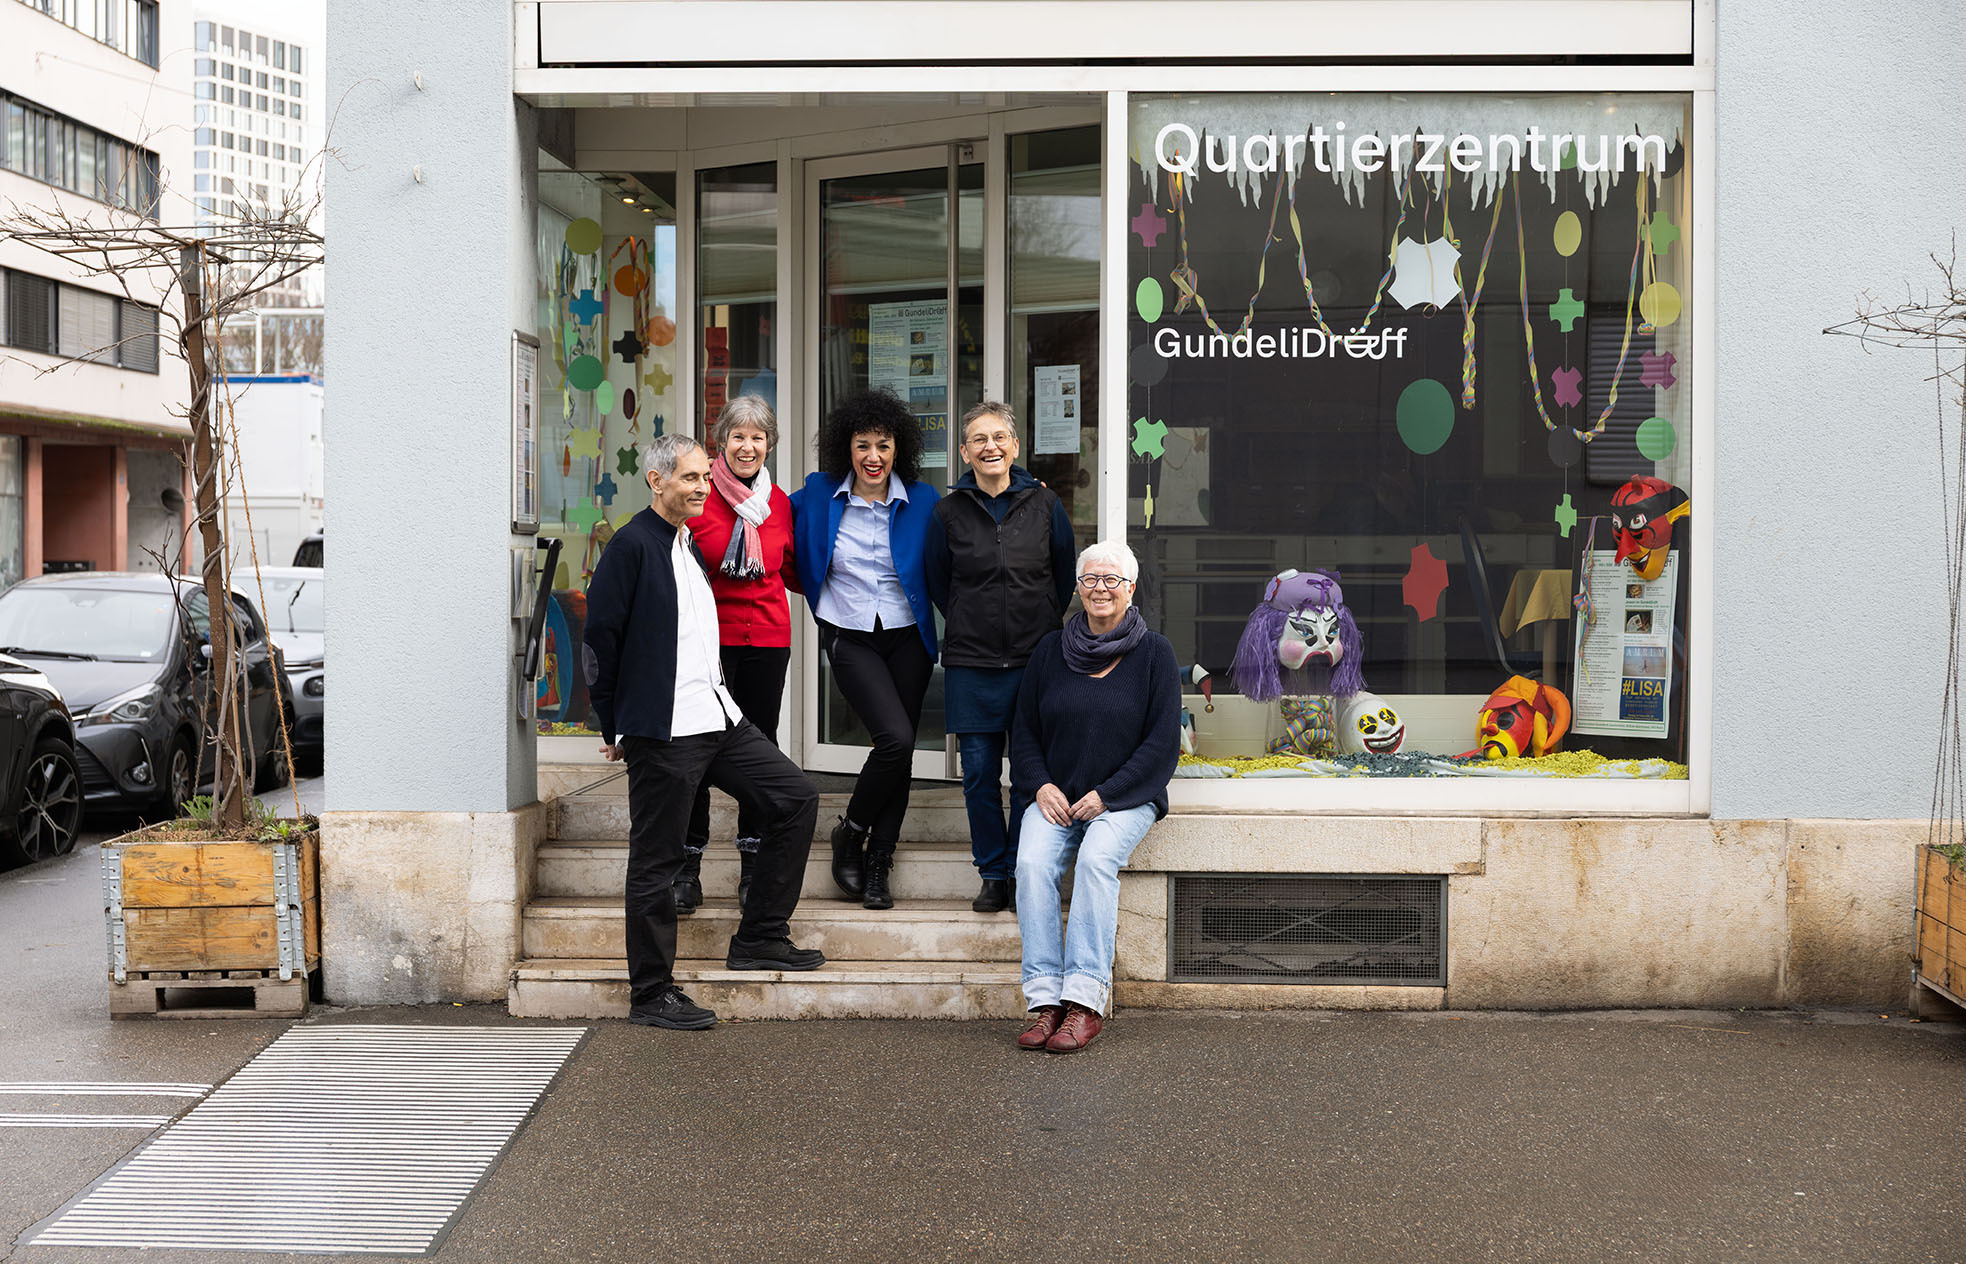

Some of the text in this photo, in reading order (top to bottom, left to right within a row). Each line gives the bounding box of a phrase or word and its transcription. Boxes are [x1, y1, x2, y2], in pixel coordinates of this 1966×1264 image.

[1155, 121, 1666, 176] Quartierzentrum
[917, 415, 946, 431] LISA
[1622, 680, 1664, 697] #LISA
